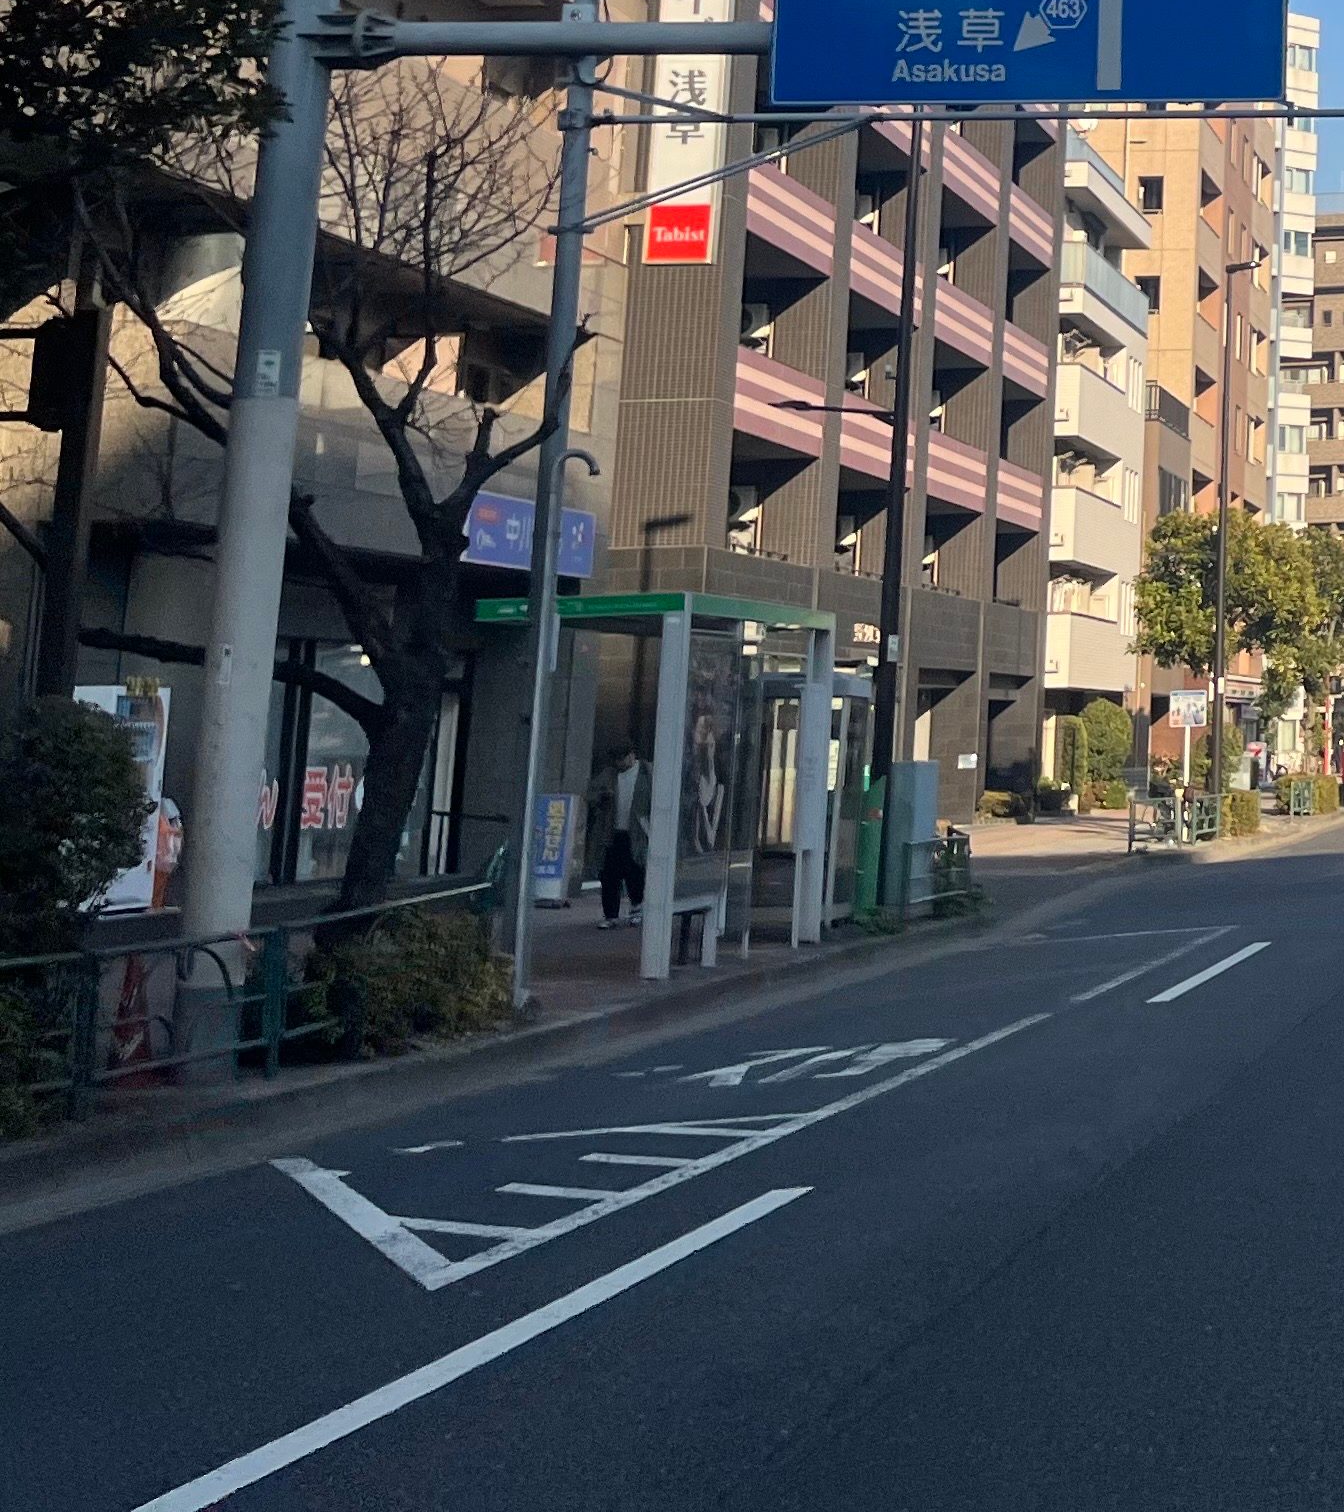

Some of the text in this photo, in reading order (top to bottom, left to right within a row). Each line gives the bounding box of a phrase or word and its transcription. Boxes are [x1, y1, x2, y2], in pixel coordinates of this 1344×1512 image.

[895, 8, 1006, 53] 浅草
[891, 60, 1007, 83] Asakusa
[653, 224, 706, 243] Tabist
